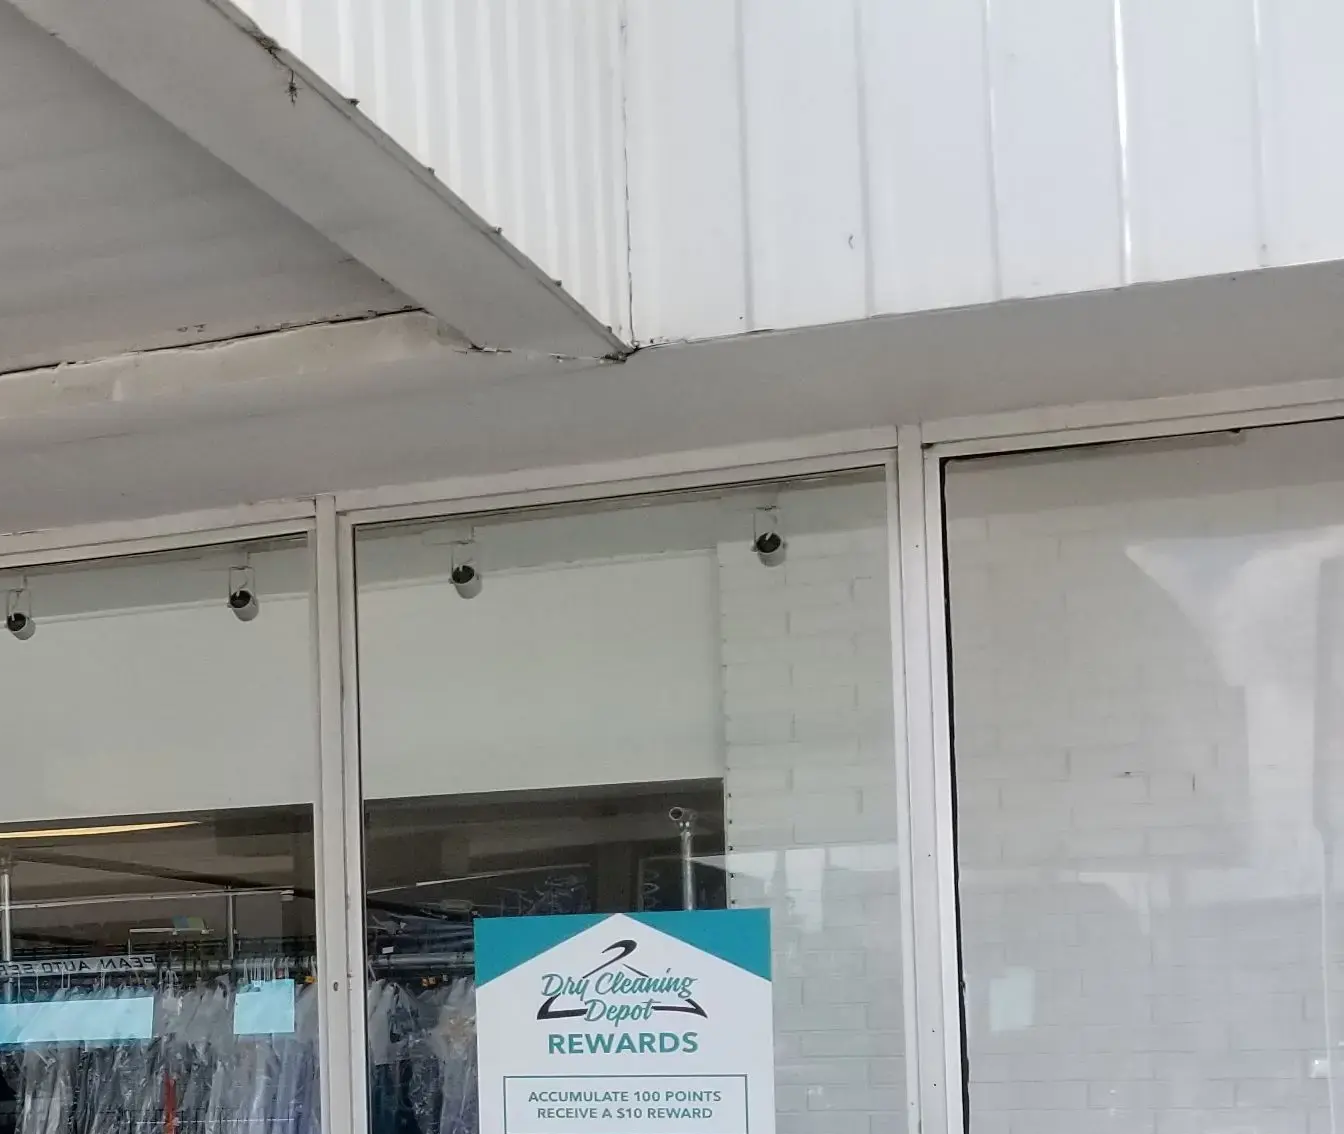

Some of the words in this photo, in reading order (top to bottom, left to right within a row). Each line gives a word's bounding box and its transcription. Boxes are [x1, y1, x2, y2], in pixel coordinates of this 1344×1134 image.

[541, 973, 589, 1001] Dry
[595, 967, 699, 999] Cleaning
[584, 998, 661, 1028] Depot
[548, 1031, 699, 1054] REWARDS
[528, 1091, 629, 1102] ACCUMULATE
[633, 1091, 659, 1102] 100
[665, 1090, 722, 1102] POINTS
[537, 1107, 597, 1119] RECEIVE
[601, 1108, 612, 1119] A
[616, 1106, 642, 1119] $10
[647, 1107, 713, 1119] REWARD
